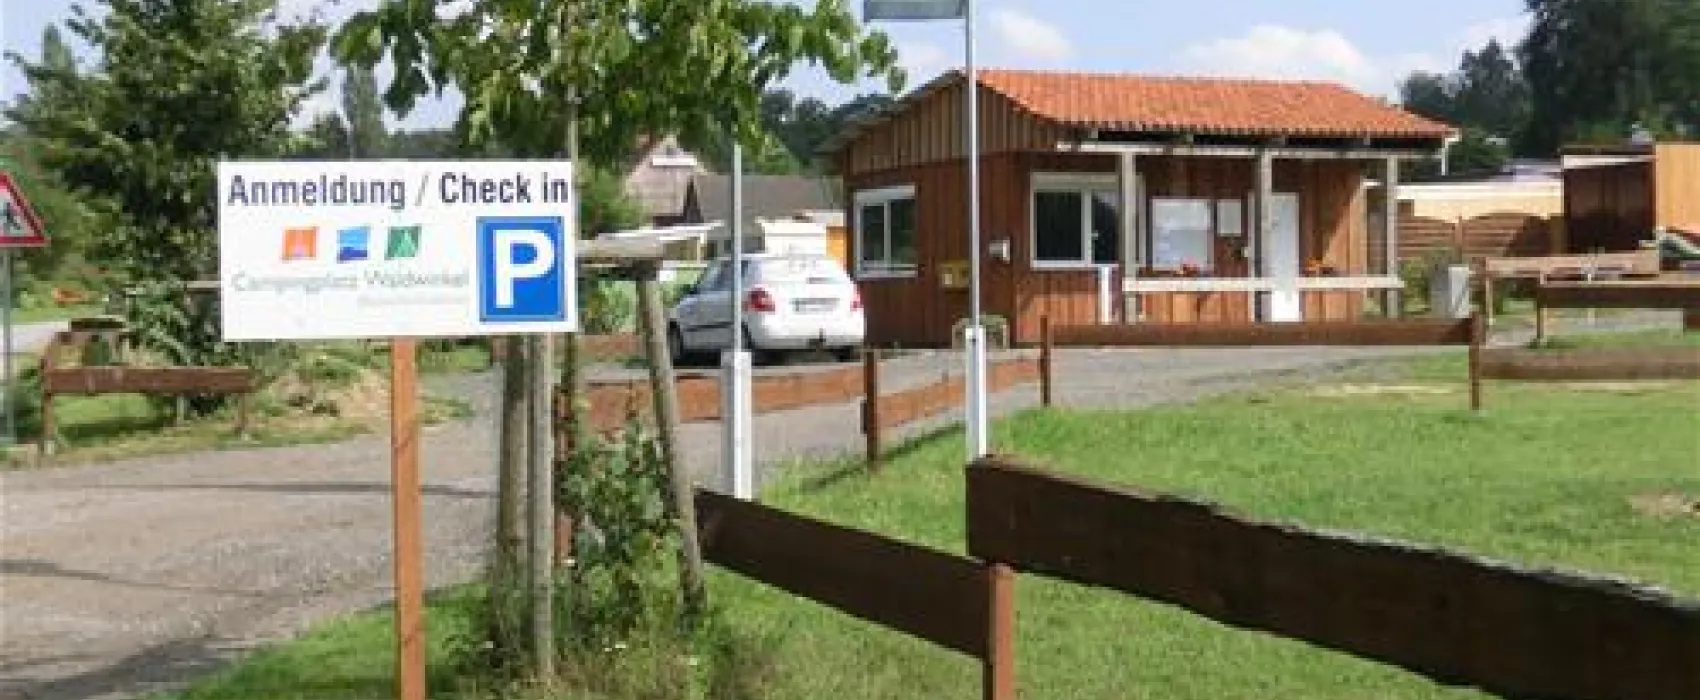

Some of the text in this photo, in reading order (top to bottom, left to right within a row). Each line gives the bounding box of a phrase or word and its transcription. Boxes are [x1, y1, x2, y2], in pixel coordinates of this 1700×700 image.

[228, 171, 569, 210] Anmeldung / Check in
[493, 229, 556, 309] P
